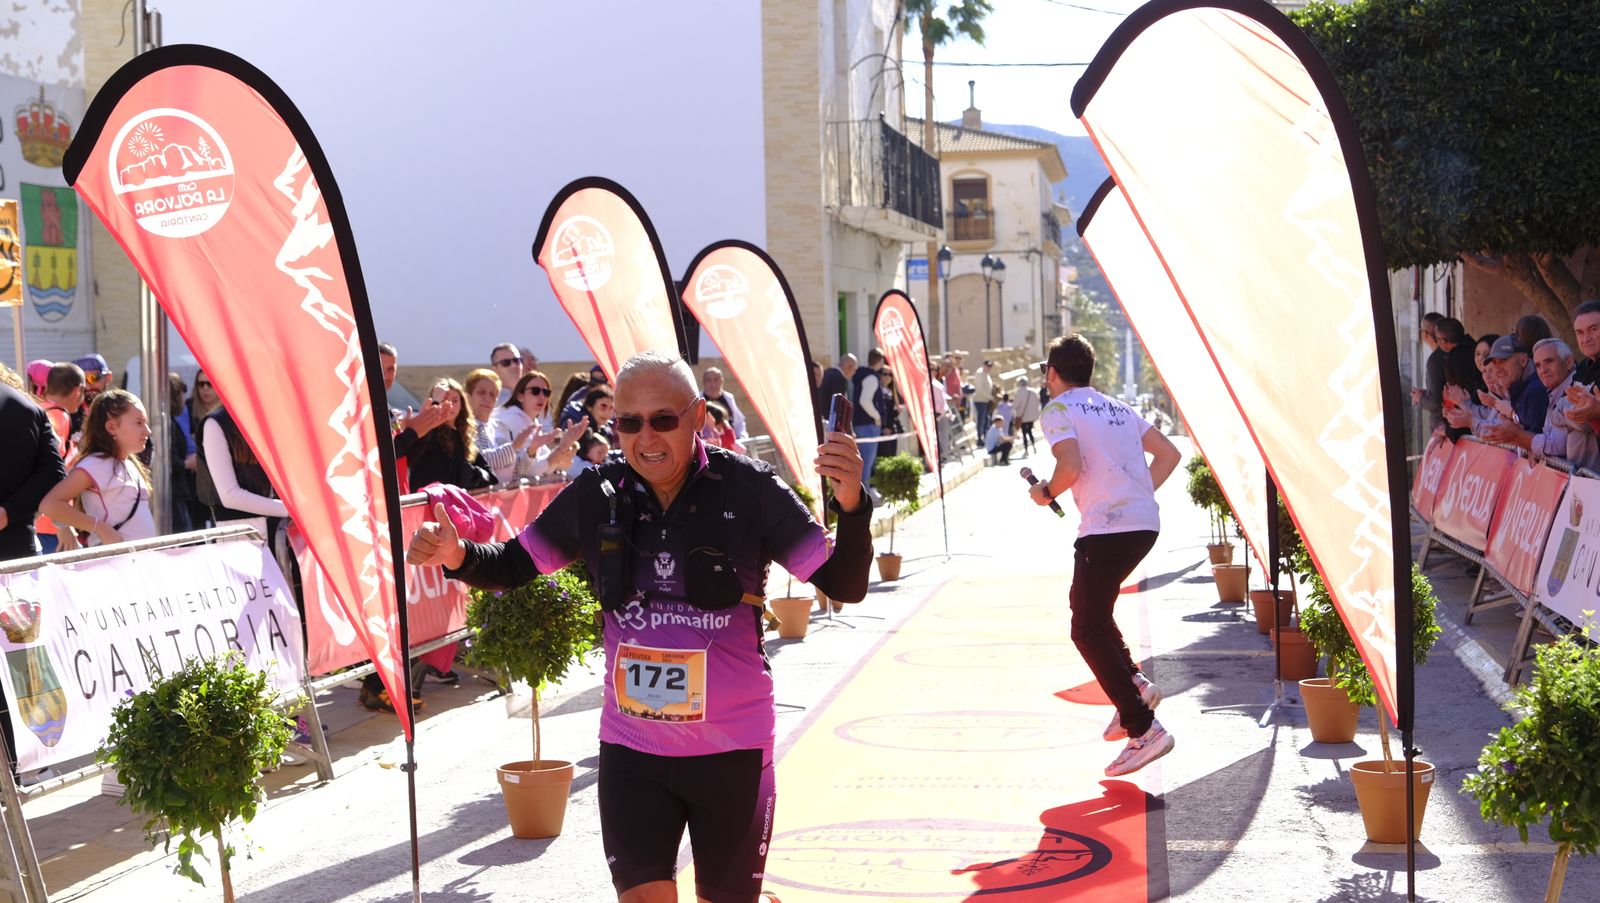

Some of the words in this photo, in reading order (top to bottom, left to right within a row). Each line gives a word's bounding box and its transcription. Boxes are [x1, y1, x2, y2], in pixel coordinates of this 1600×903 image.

[65, 585, 237, 638] AYUNTAMIENTO
[244, 577, 273, 602] DE
[650, 611, 732, 630] primaflor
[73, 607, 288, 699] CANTORIA
[627, 663, 686, 690] 172
[761, 795, 774, 841] Espabrok
